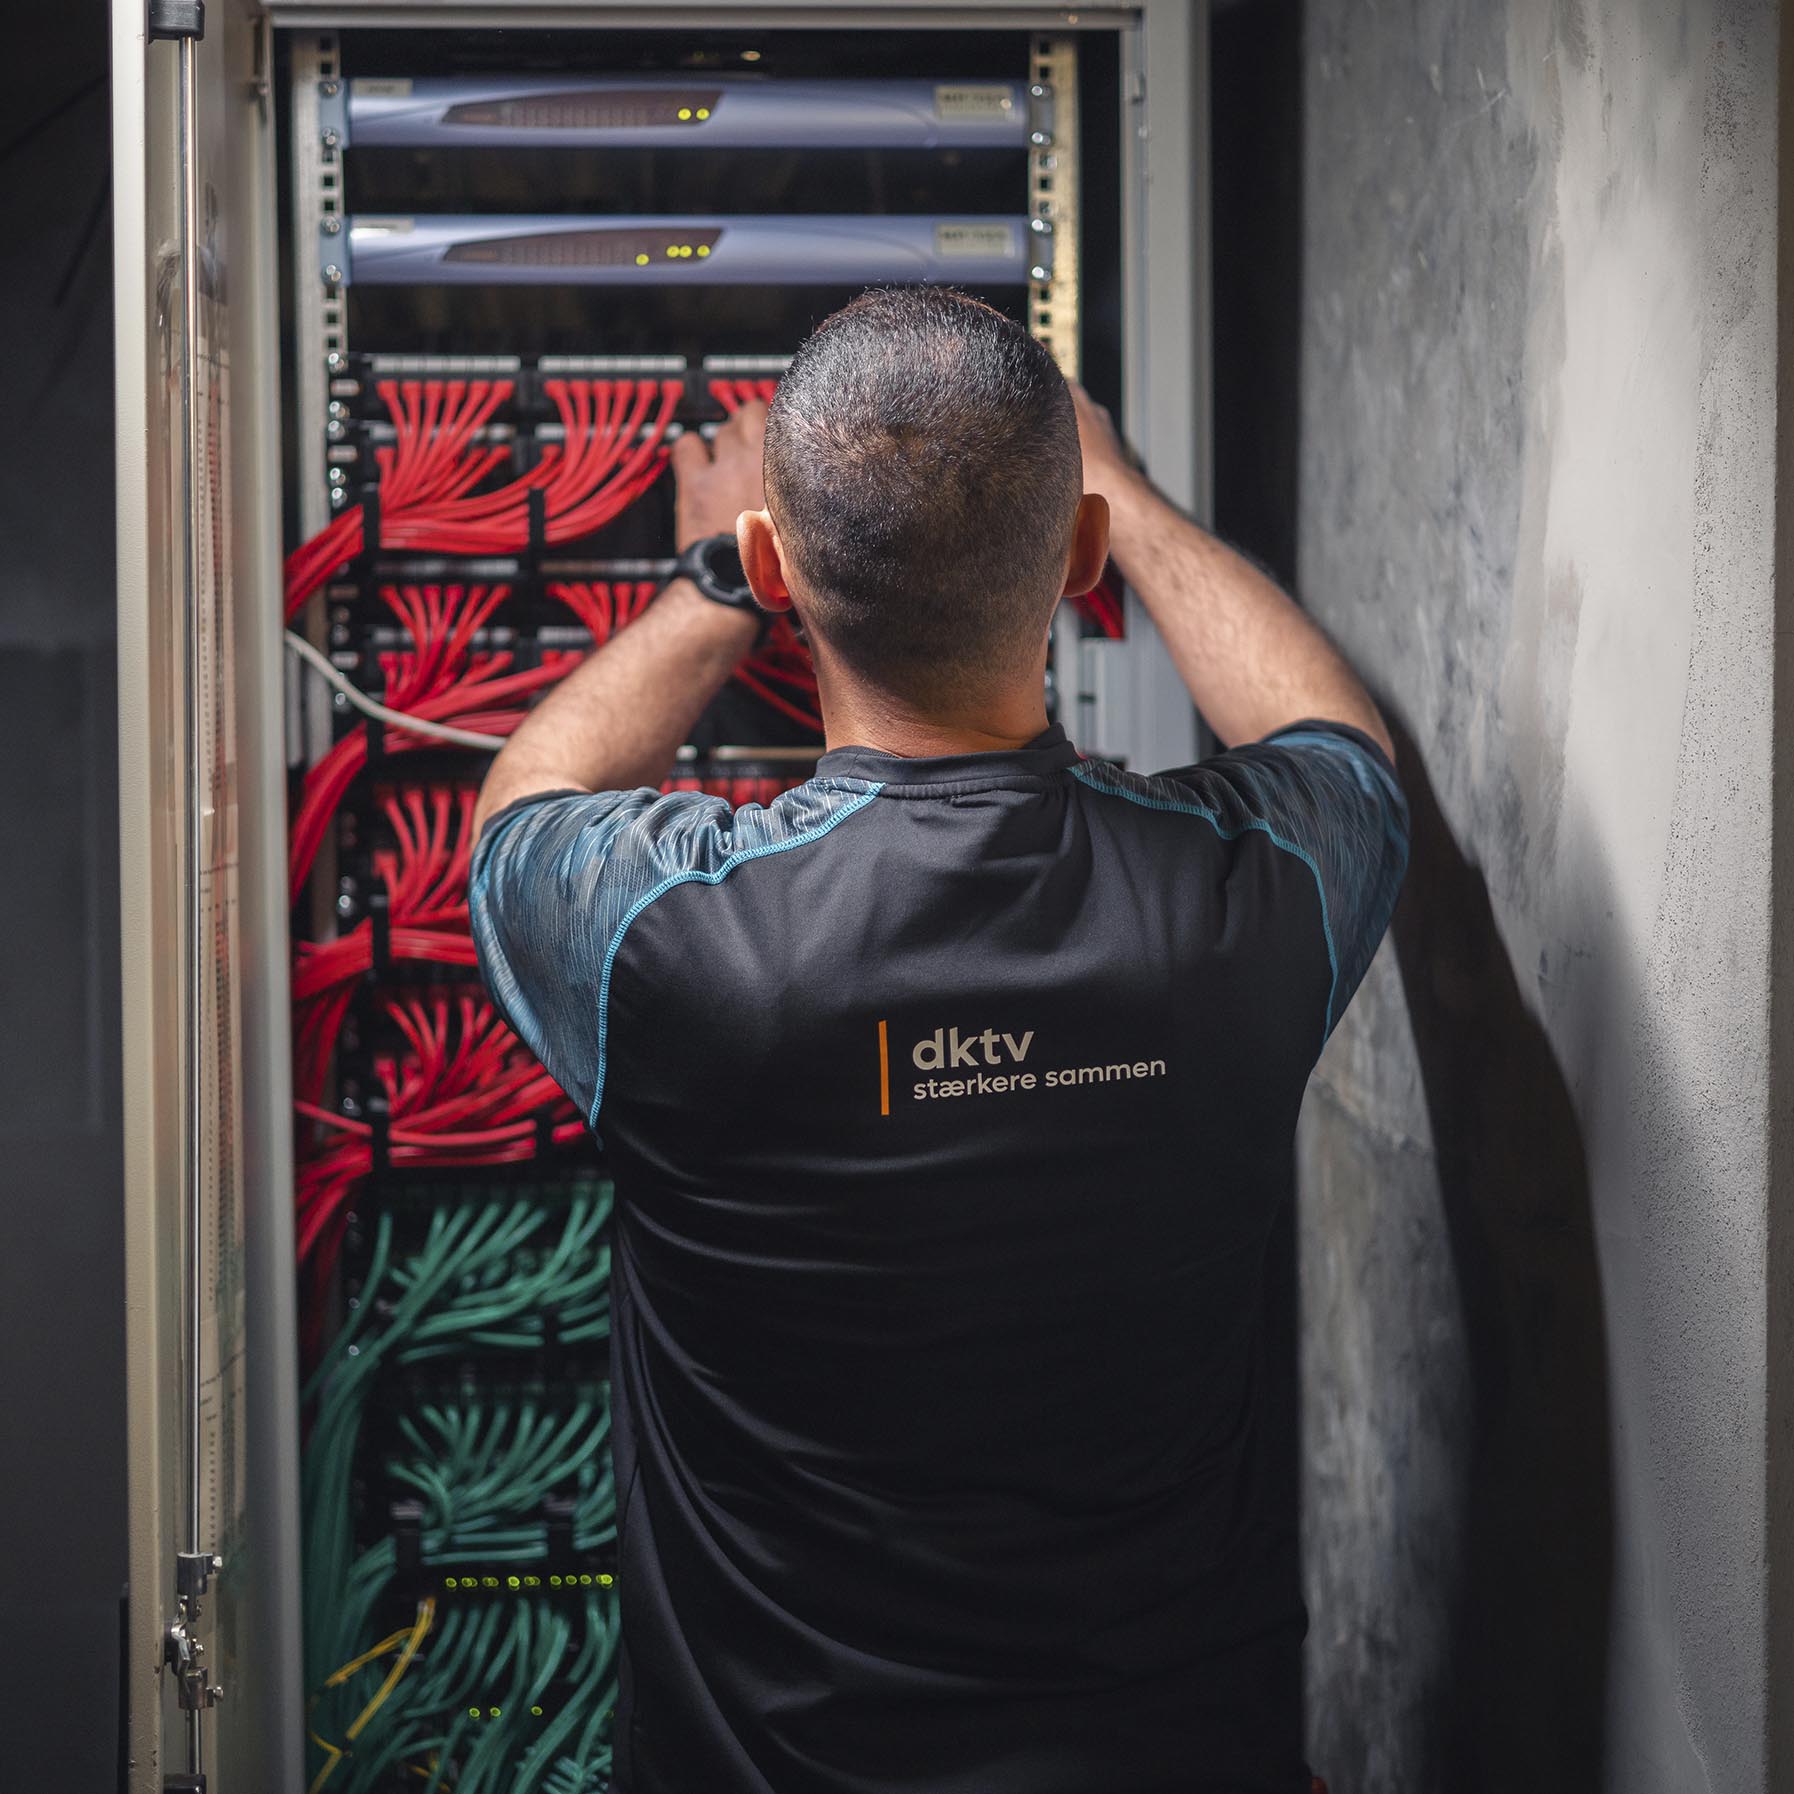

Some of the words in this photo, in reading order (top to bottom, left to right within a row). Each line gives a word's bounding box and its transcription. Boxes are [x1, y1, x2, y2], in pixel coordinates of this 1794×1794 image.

[912, 1026, 1035, 1071] dktv
[913, 1072, 1037, 1100] stærkere
[1045, 1059, 1167, 1087] sammen
